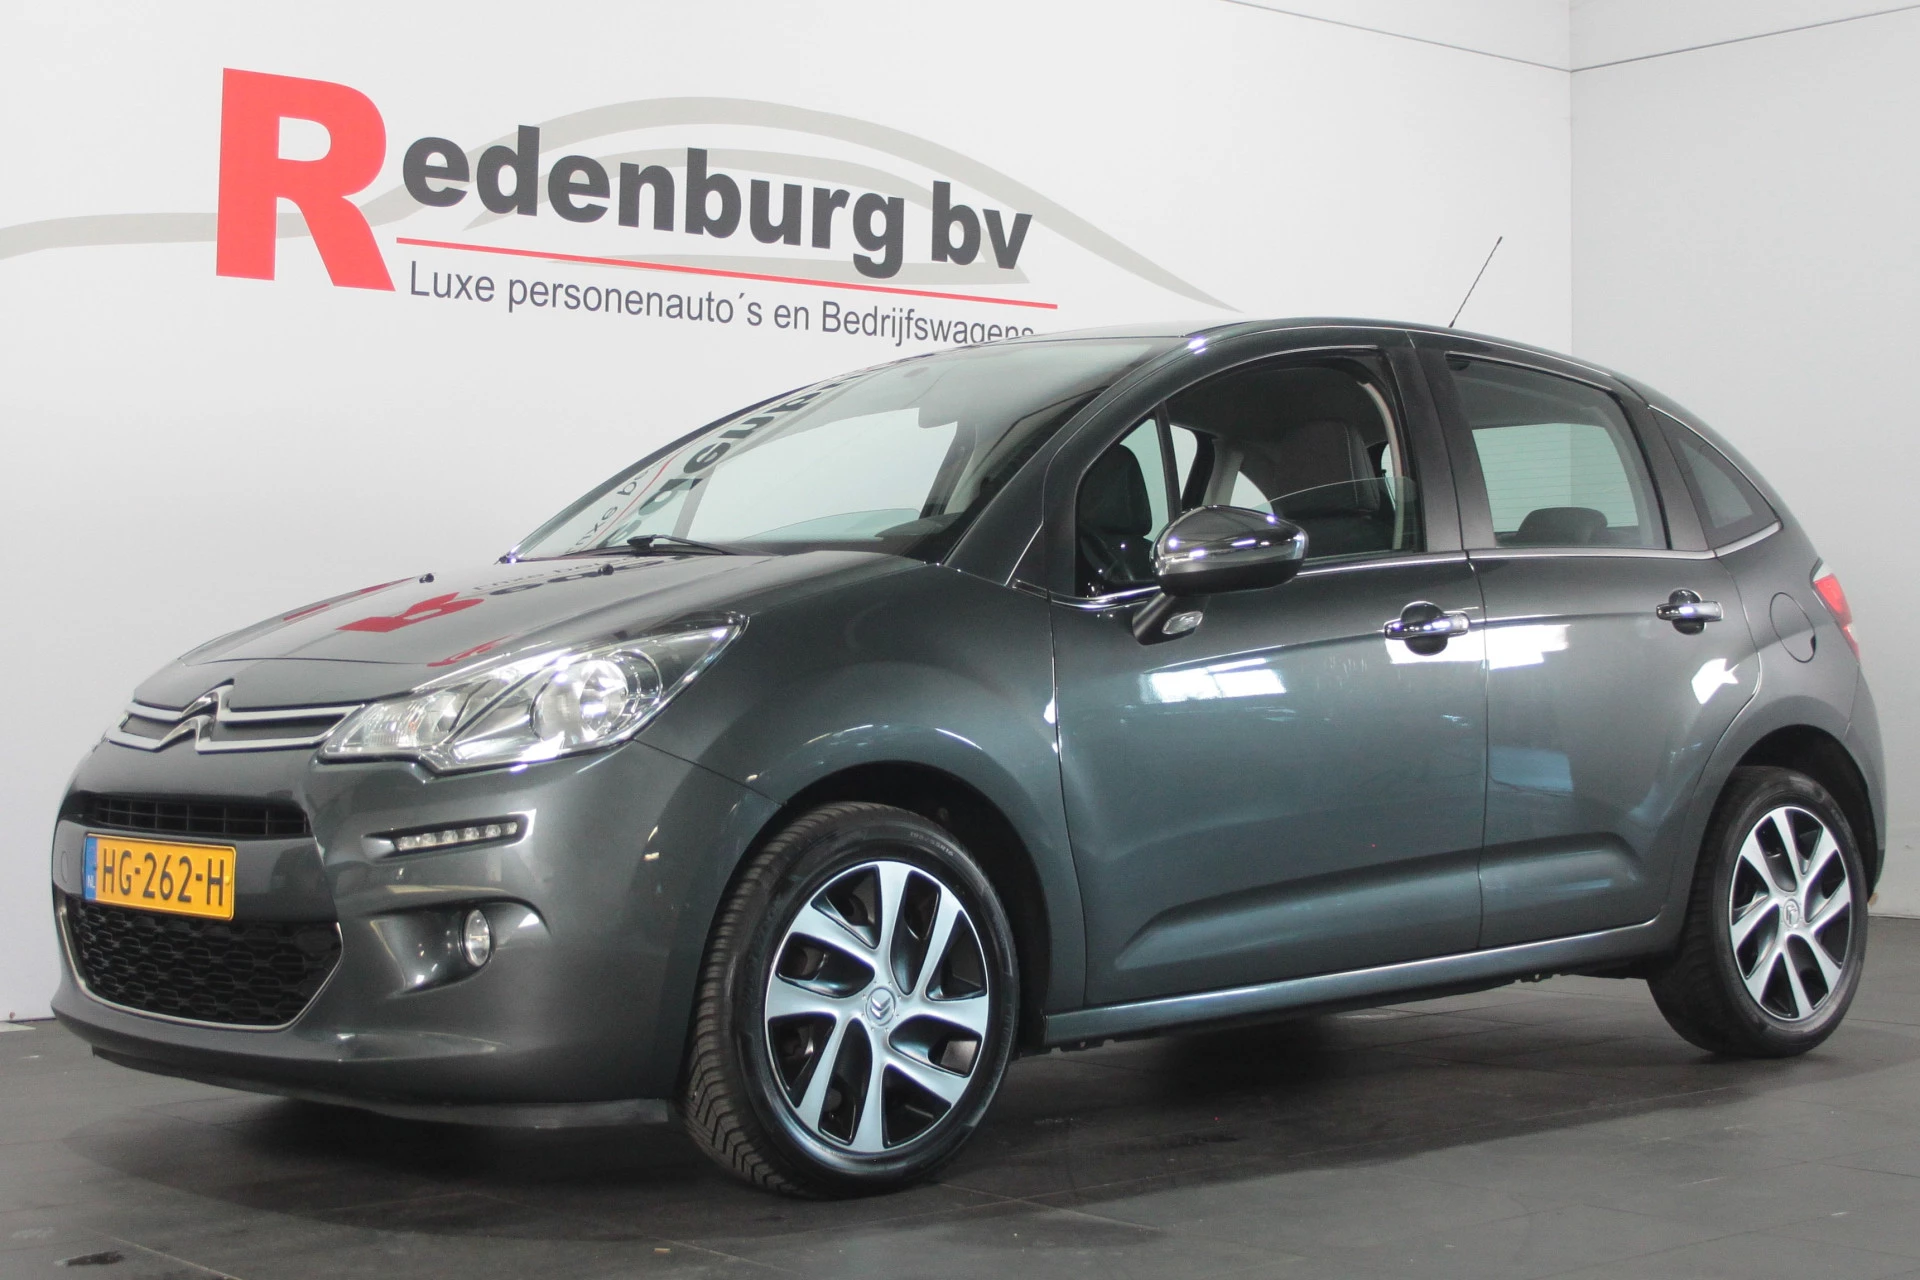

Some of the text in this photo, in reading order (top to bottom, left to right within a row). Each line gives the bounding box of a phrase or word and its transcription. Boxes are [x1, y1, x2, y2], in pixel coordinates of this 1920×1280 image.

[216, 67, 1034, 291] Redenburg bv
[410, 260, 496, 303] Luxe
[773, 304, 810, 331] en
[102, 848, 225, 907] HG-262-H
